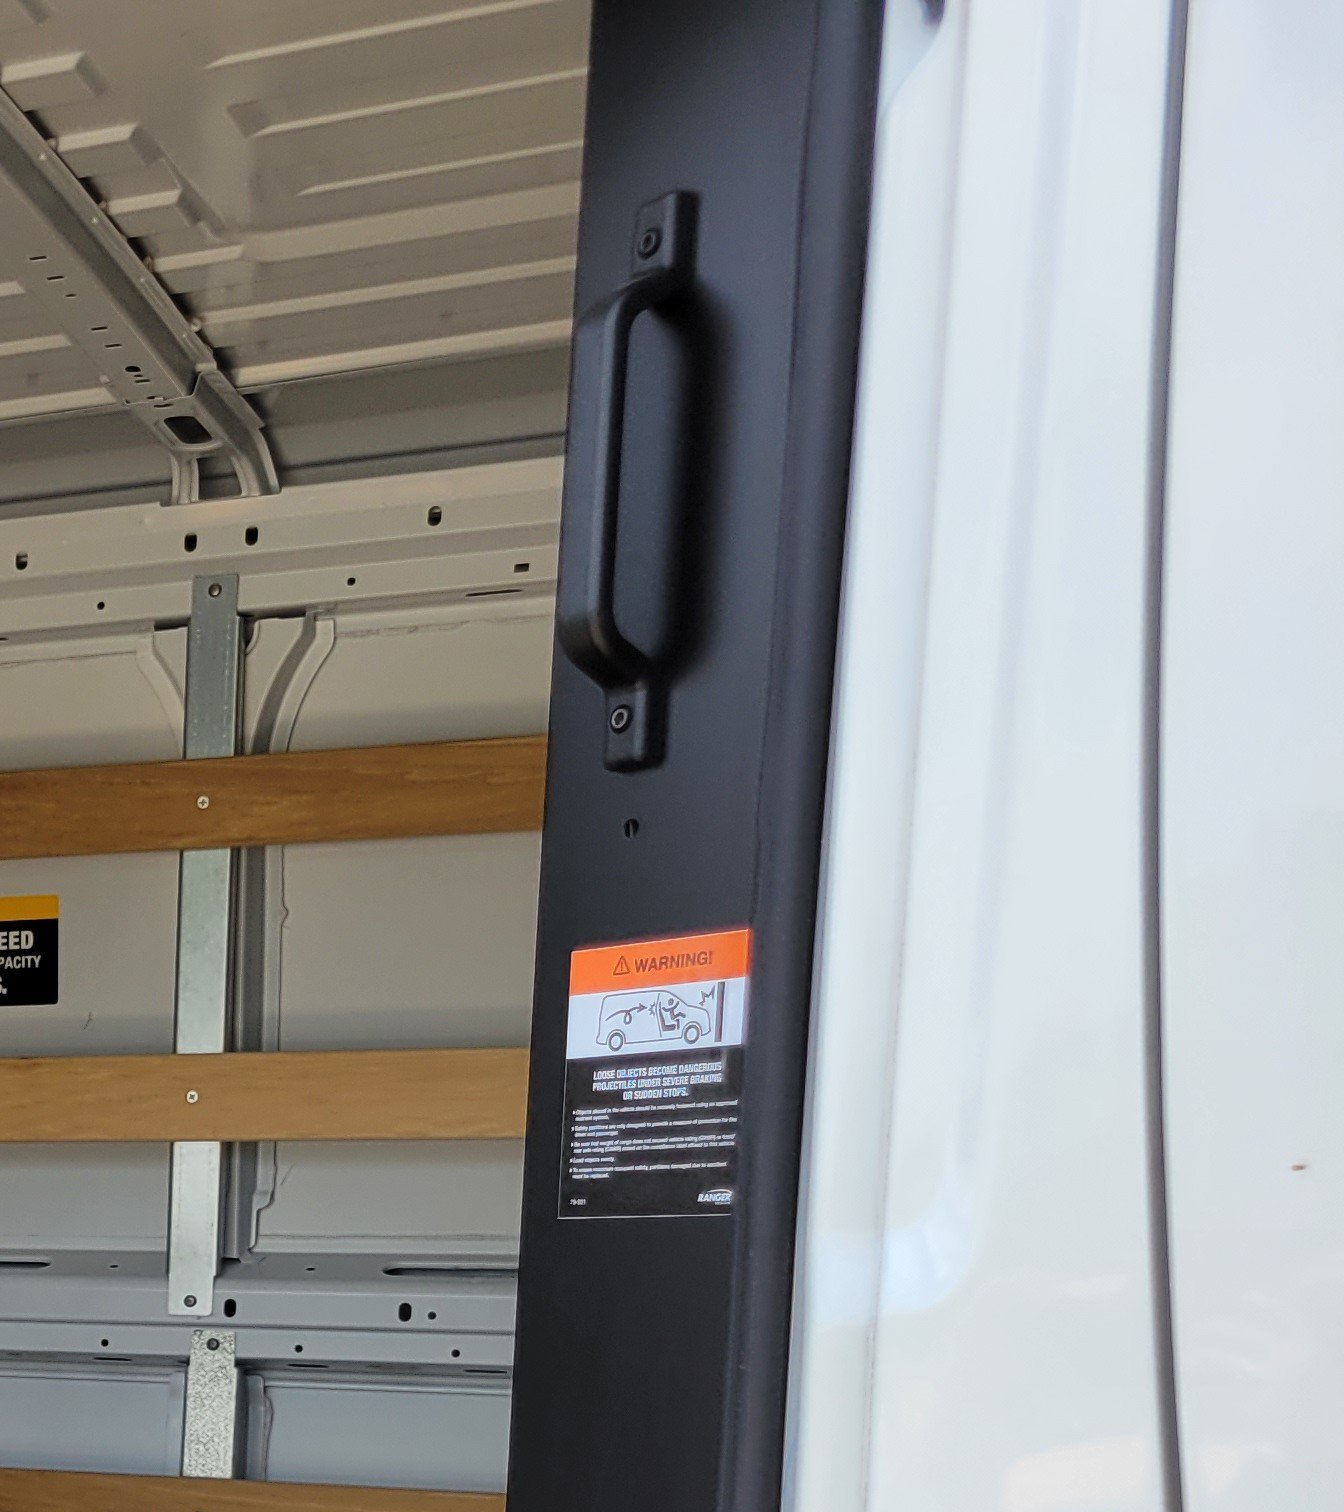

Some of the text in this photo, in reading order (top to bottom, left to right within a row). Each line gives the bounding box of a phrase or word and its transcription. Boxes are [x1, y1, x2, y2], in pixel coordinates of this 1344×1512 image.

[634, 951, 713, 973] WARNING!
[593, 1070, 616, 1080] LOOSE
[633, 1089, 662, 1100] SUDDEN
